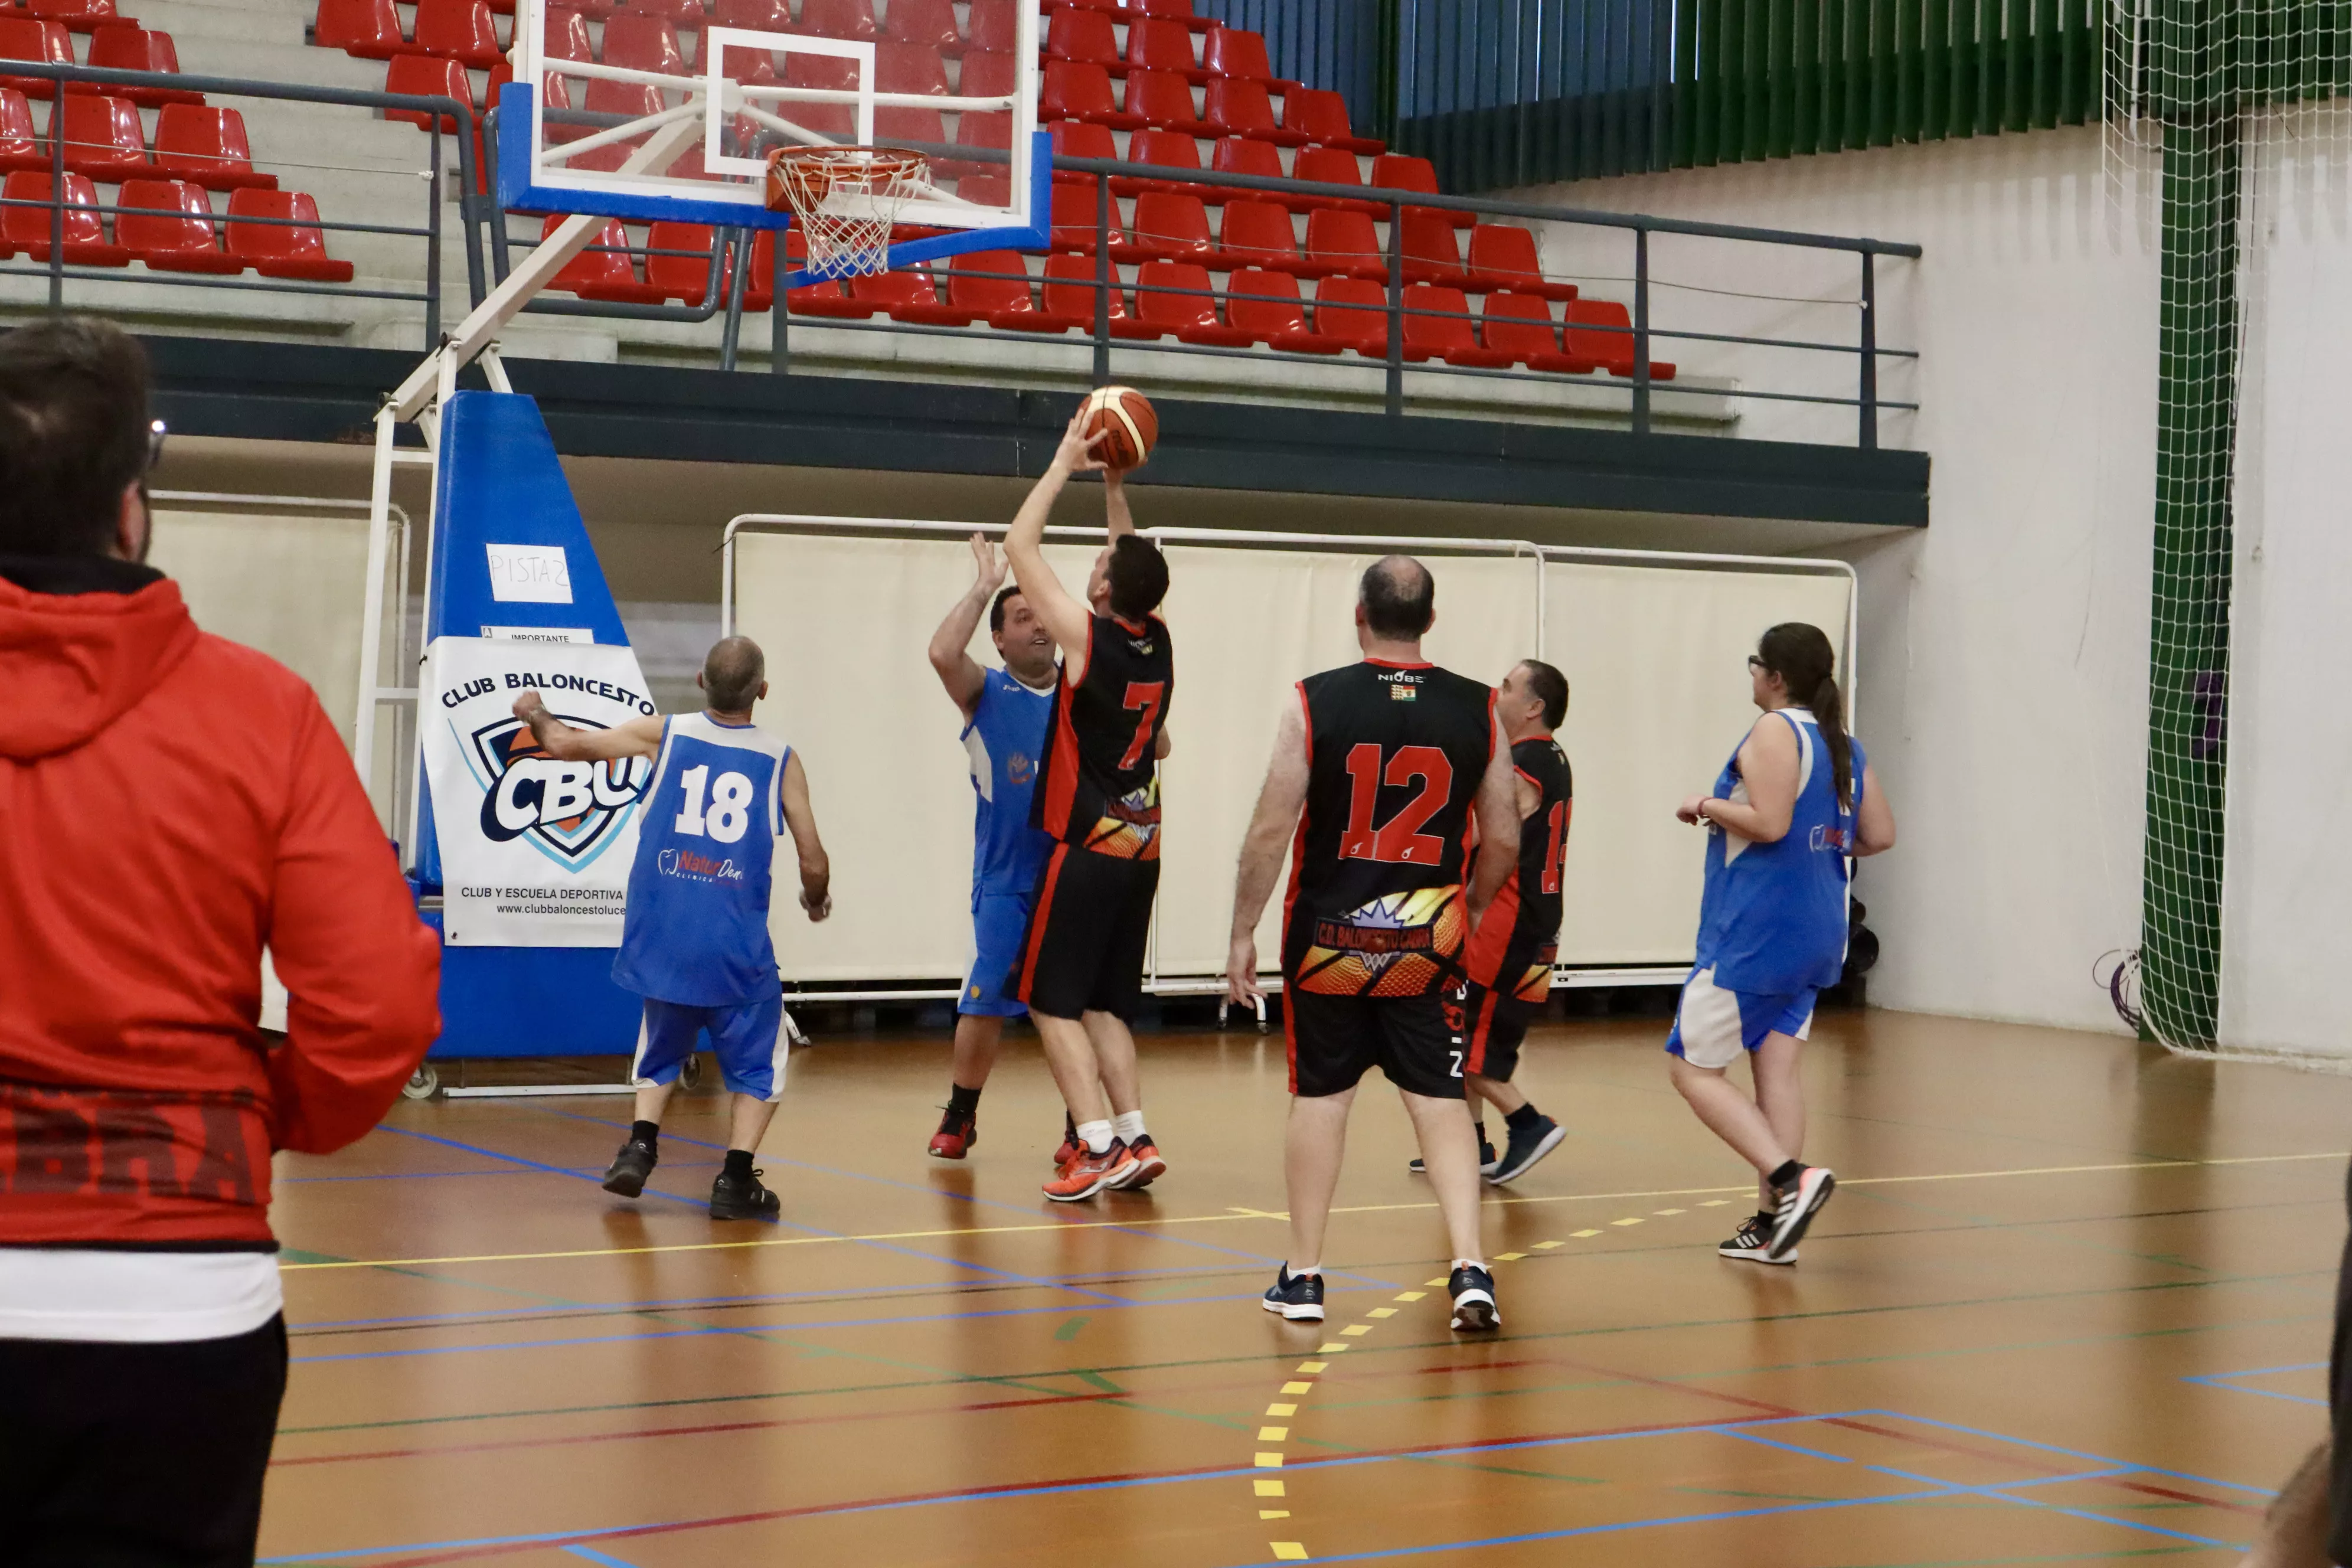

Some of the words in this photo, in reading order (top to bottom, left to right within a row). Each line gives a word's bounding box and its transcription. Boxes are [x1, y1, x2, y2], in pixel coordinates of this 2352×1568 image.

[511, 634, 570, 643] IMPORTANTE
[442, 677, 496, 708] CLUB
[505, 673, 655, 716] BALONCESTO
[1378, 670, 1423, 683] NIOBE
[1118, 681, 1164, 770] 7
[675, 765, 753, 843] 18
[1338, 743, 1453, 866] 12
[462, 887, 492, 897] CLUB
[496, 888, 502, 897] Y
[505, 888, 557, 899] ESCUELA
[560, 890, 623, 900] DEPORTIVA
[497, 904, 626, 915] www.clubbaloncestoluce
[0, 1105, 255, 1206] BRA
